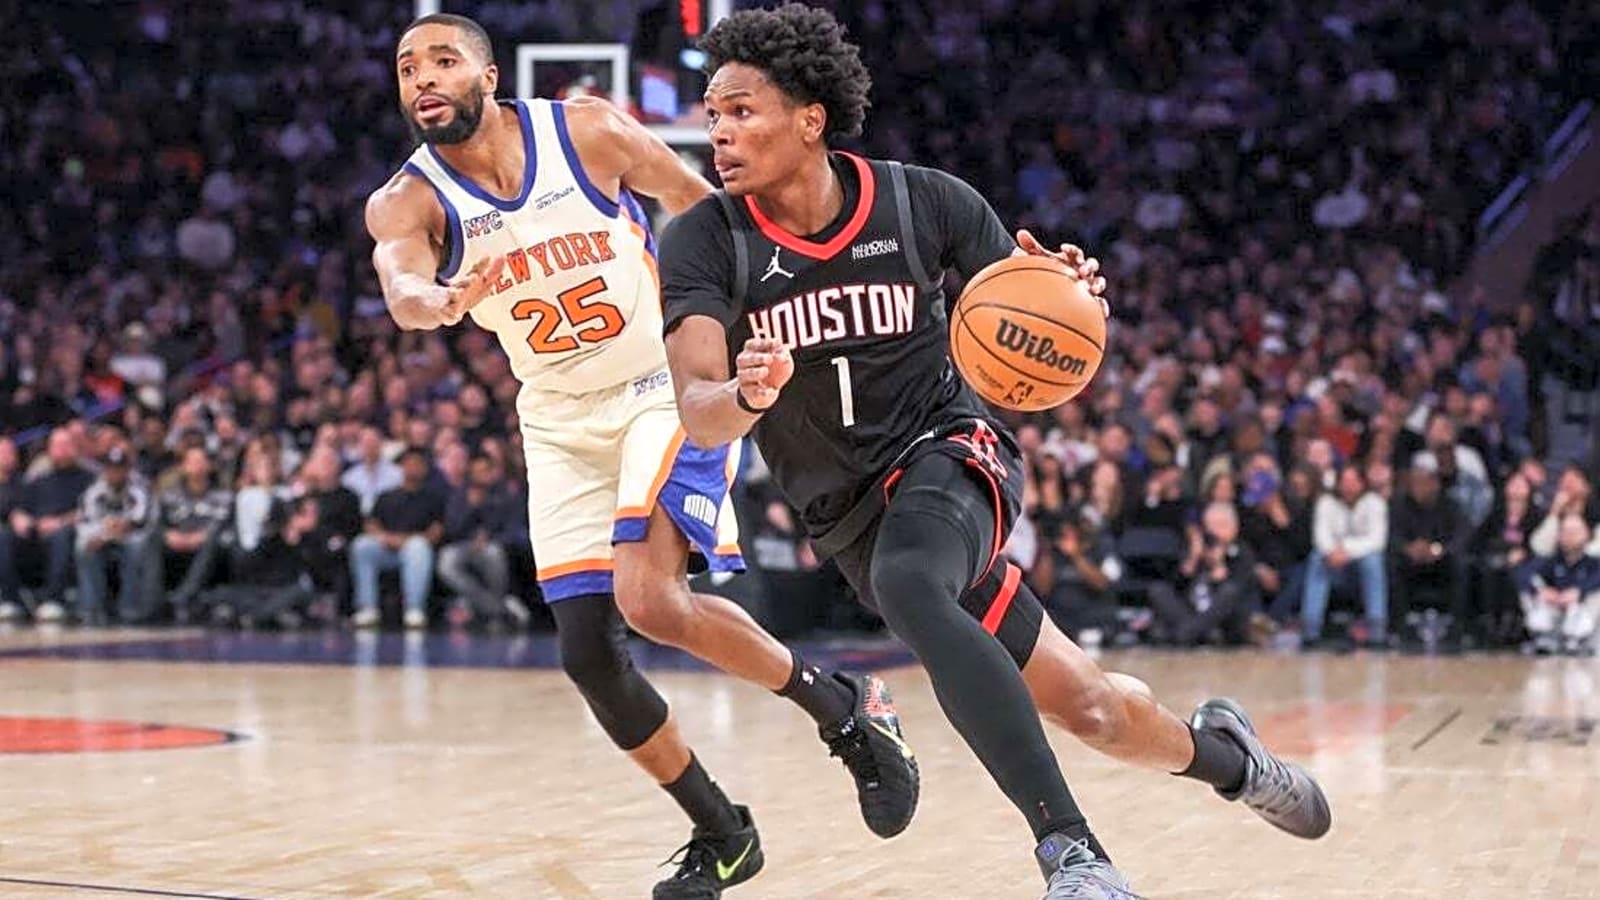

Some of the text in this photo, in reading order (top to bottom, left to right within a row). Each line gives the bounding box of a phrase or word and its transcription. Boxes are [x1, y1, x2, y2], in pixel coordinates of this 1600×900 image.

[526, 231, 616, 277] YORK
[510, 275, 626, 354] 25
[748, 284, 915, 350] HOUSTON
[996, 317, 1087, 377] Wilson
[831, 355, 855, 428] 1
